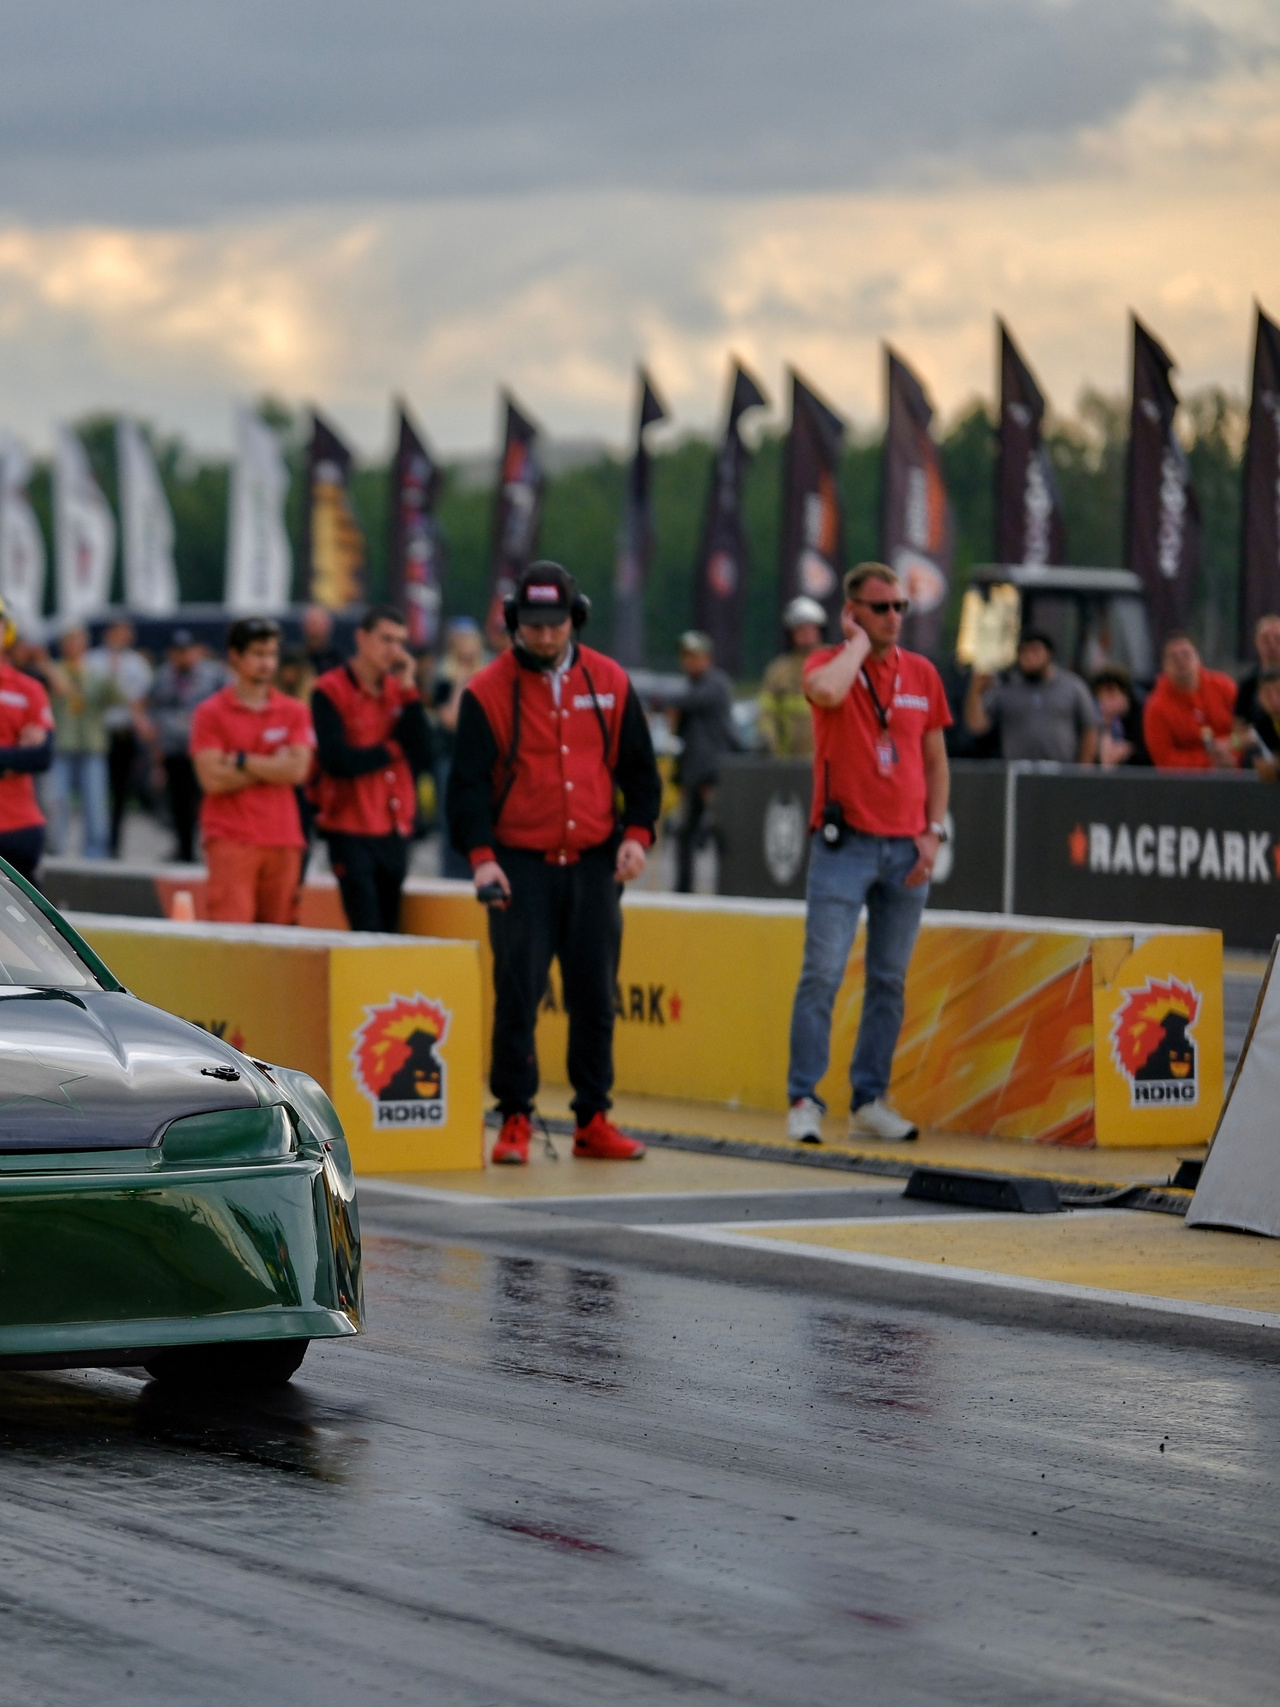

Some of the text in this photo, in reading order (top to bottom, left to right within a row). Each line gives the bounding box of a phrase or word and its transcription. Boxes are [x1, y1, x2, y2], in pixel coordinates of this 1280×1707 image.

[1088, 822, 1272, 884] RACEPARK
[1134, 1082, 1195, 1103] RDRC
[378, 1104, 442, 1121] RDRC
